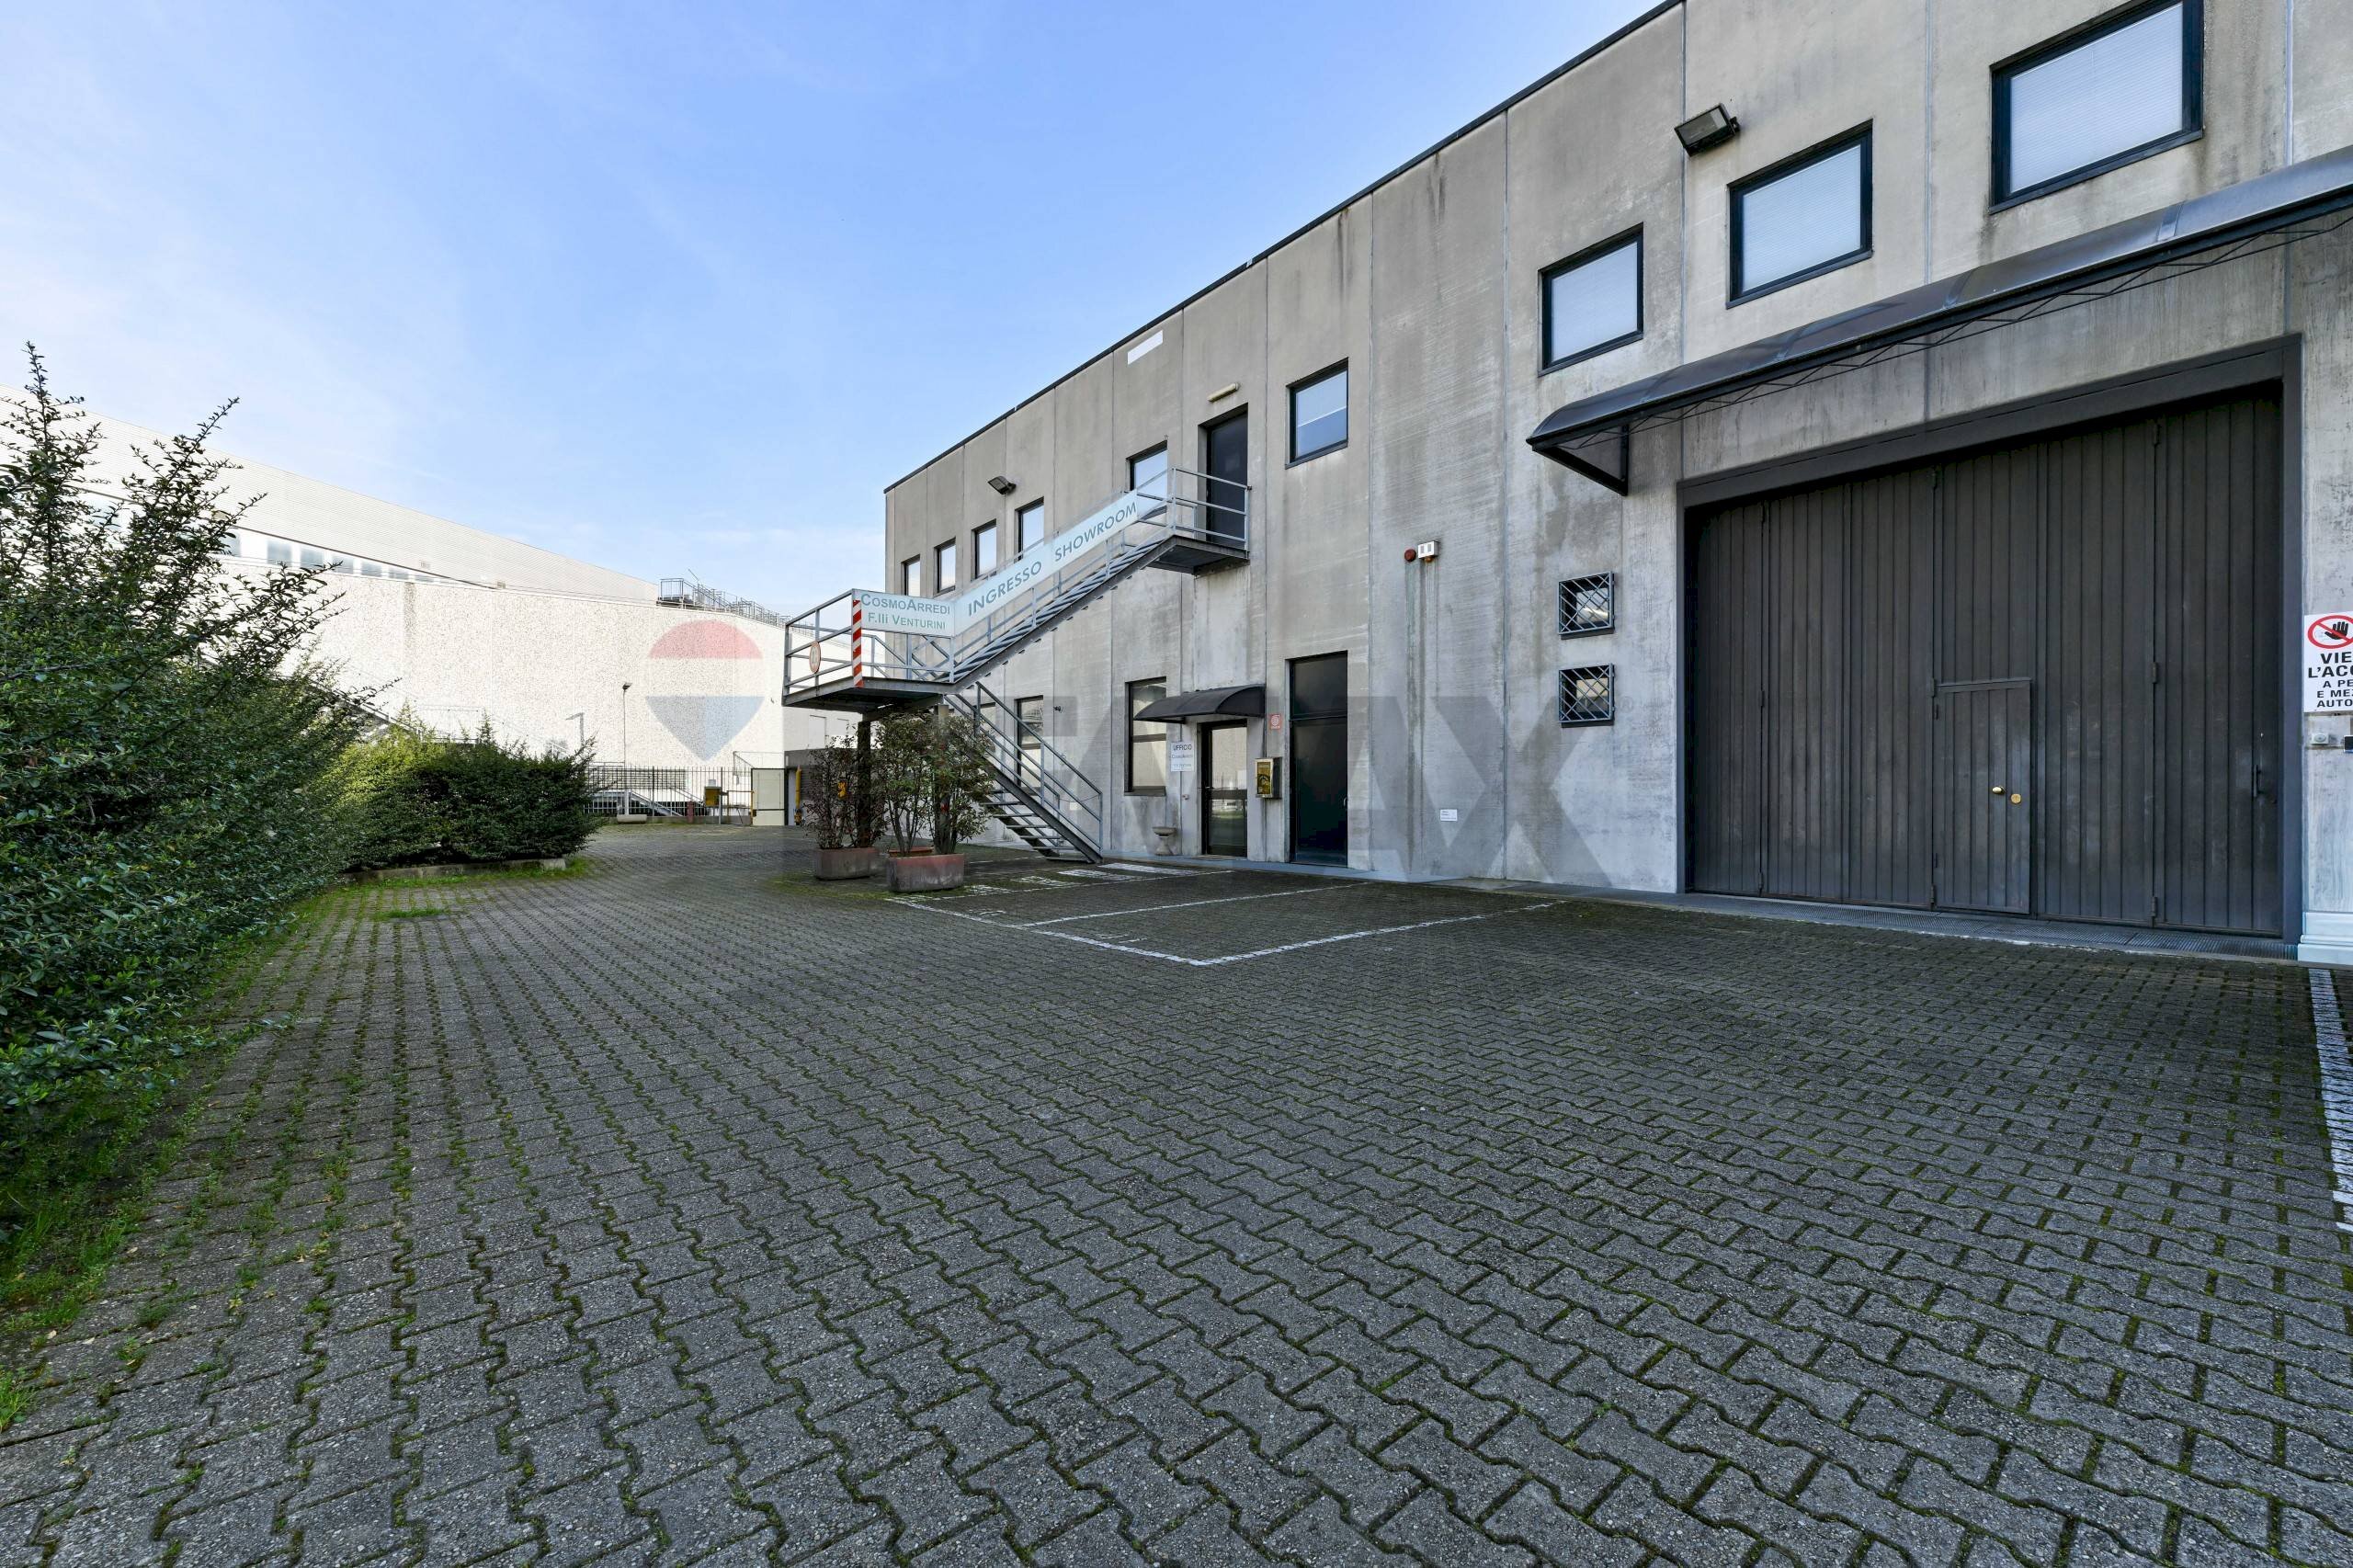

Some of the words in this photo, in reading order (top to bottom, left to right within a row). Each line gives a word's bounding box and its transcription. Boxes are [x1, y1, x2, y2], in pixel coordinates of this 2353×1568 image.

[967, 561, 1042, 617] INGRESSO
[1054, 501, 1137, 562] SHOWROOM
[892, 615, 946, 630] VENTURINI
[2308, 665, 2353, 678] L'AC
[2323, 680, 2332, 688] A
[2317, 690, 2325, 699] E
[2330, 688, 2353, 698] ME
